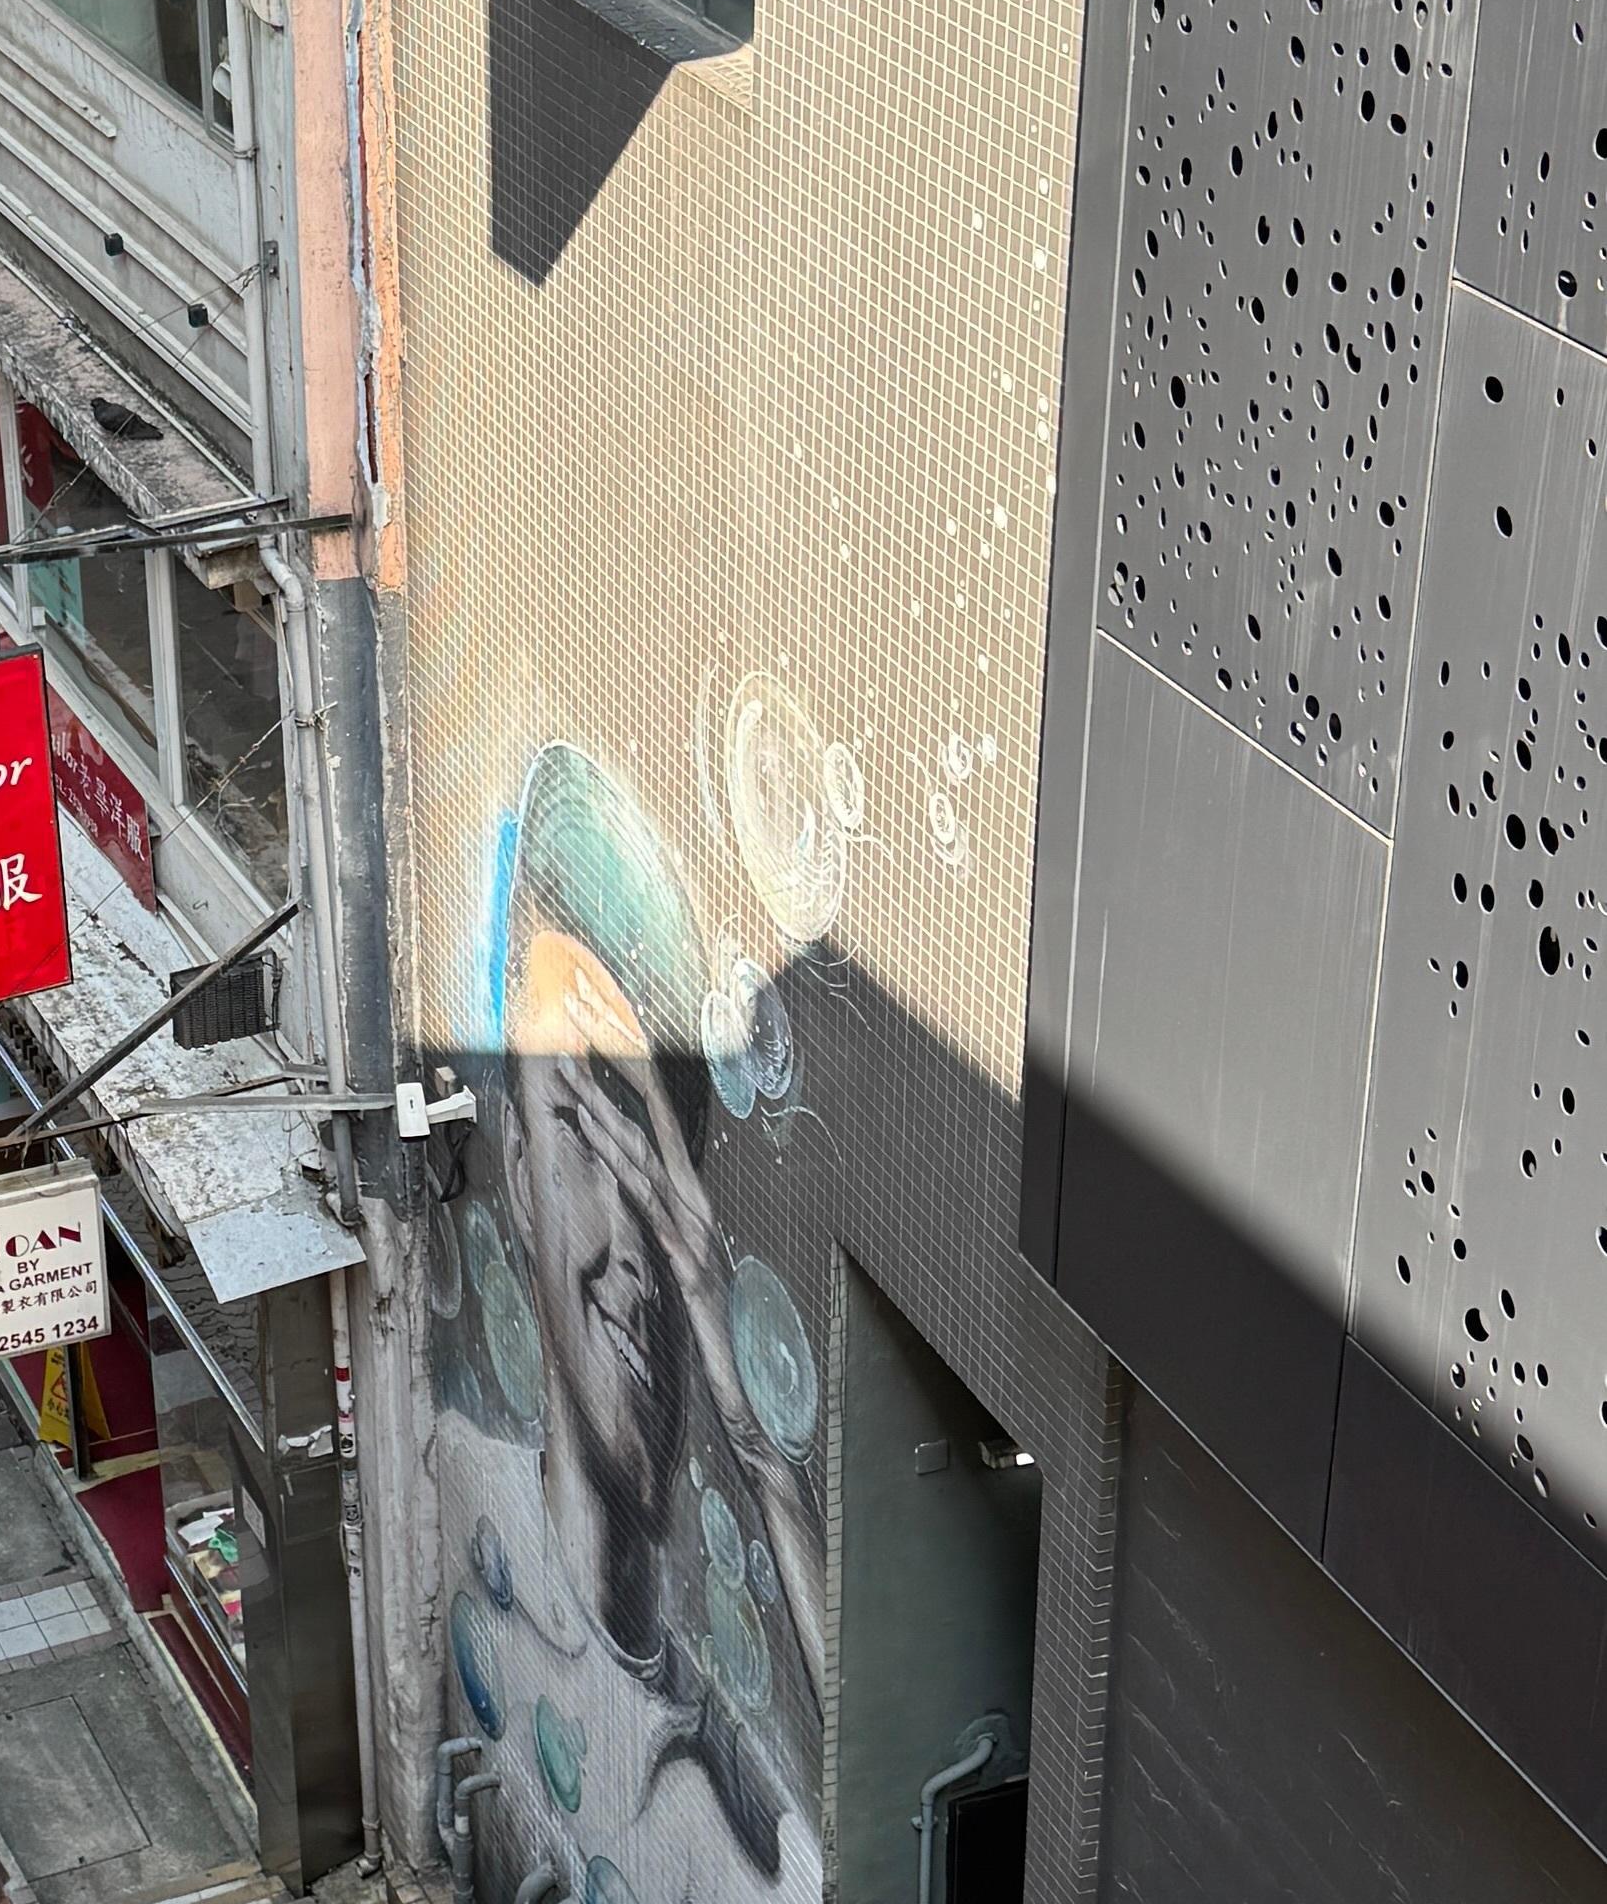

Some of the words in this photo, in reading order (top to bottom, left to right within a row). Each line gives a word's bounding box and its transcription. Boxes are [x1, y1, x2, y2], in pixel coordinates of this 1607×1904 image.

[8, 1262, 93, 1292] GARMENT
[16, 1257, 40, 1274] BY
[51, 1316, 100, 1340] 1234
